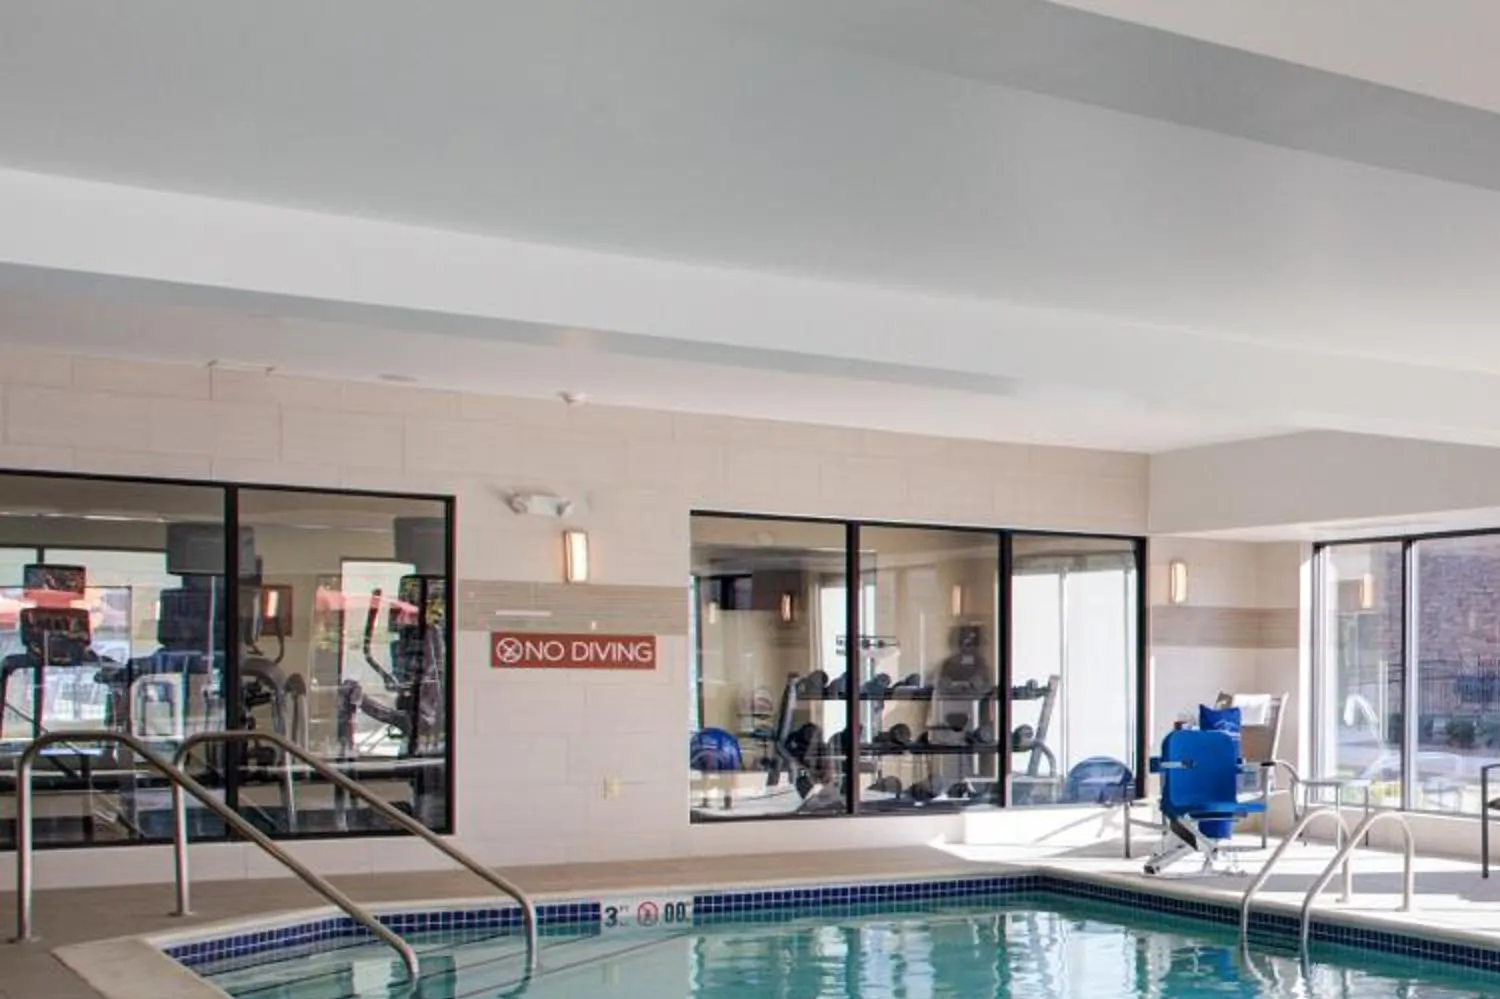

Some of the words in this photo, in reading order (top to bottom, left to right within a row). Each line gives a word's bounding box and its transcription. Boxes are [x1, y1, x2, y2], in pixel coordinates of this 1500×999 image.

[525, 641, 565, 661] NO
[571, 641, 653, 662] DIVING
[605, 906, 618, 928] 3
[664, 901, 685, 923] 00
